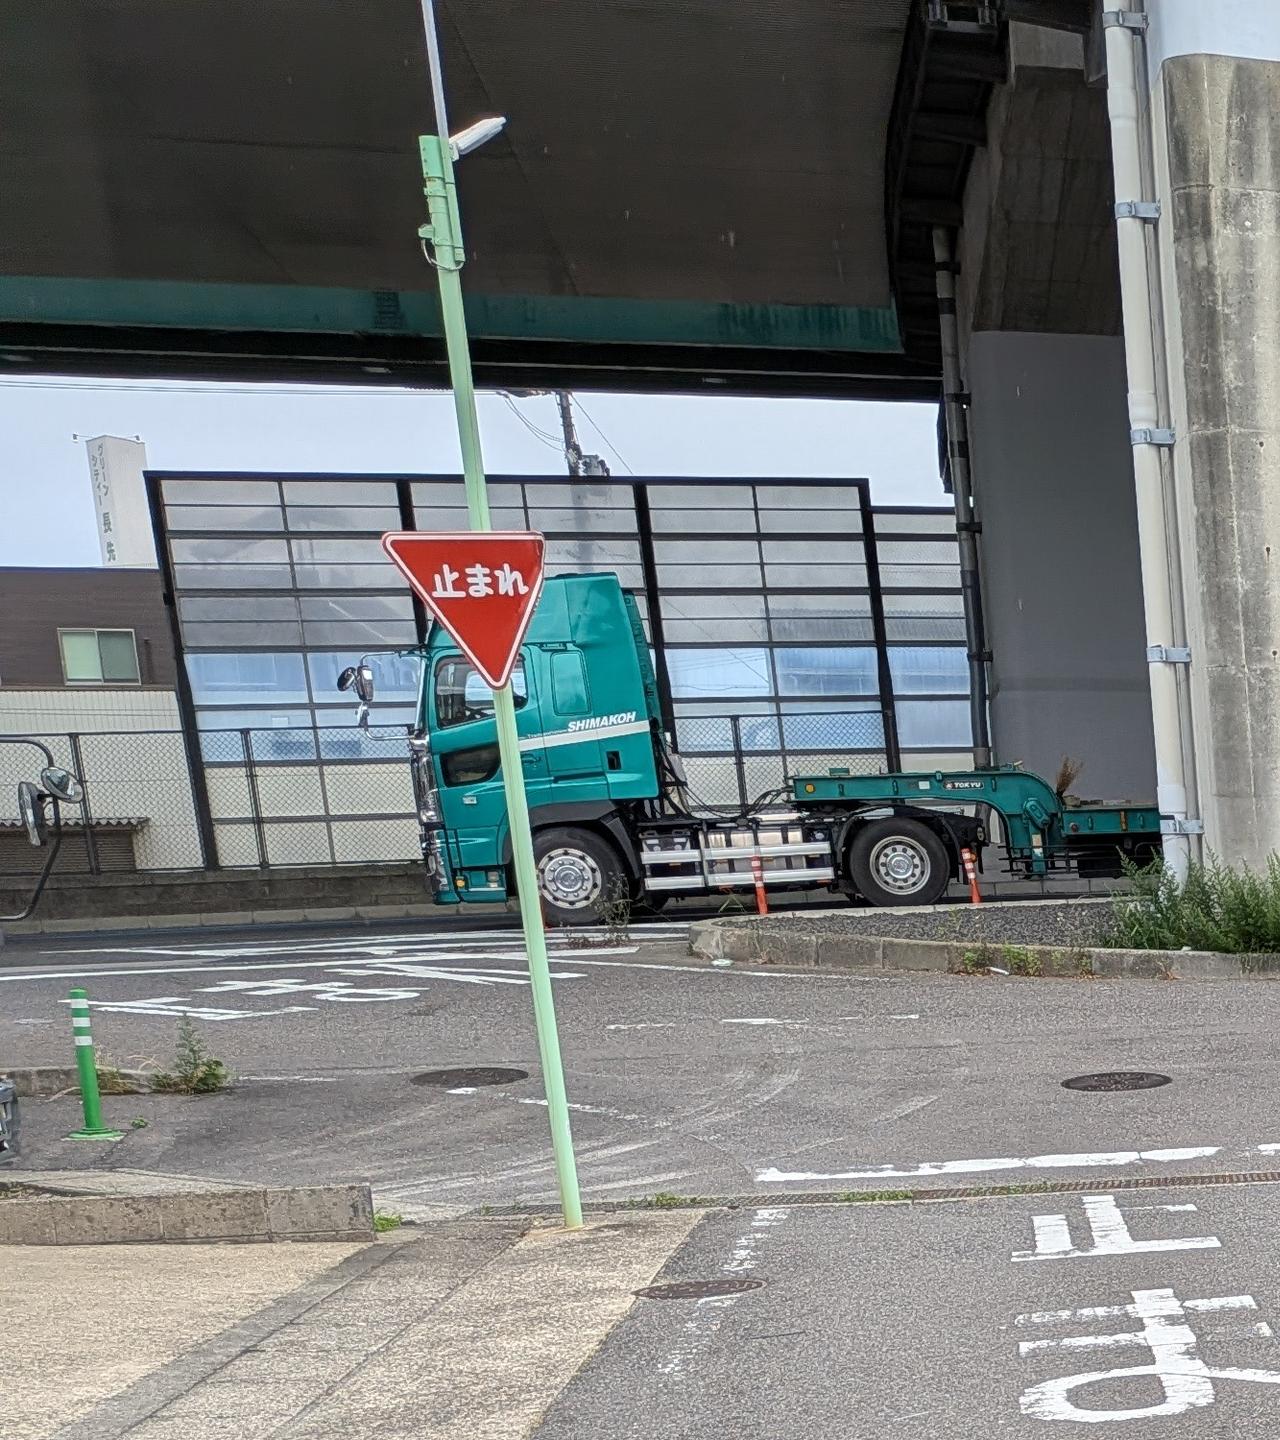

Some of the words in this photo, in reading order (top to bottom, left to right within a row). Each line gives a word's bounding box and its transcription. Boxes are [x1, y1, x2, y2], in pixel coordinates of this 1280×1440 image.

[432, 562, 529, 598] 止まれ
[567, 711, 637, 732] SHIMAKOH
